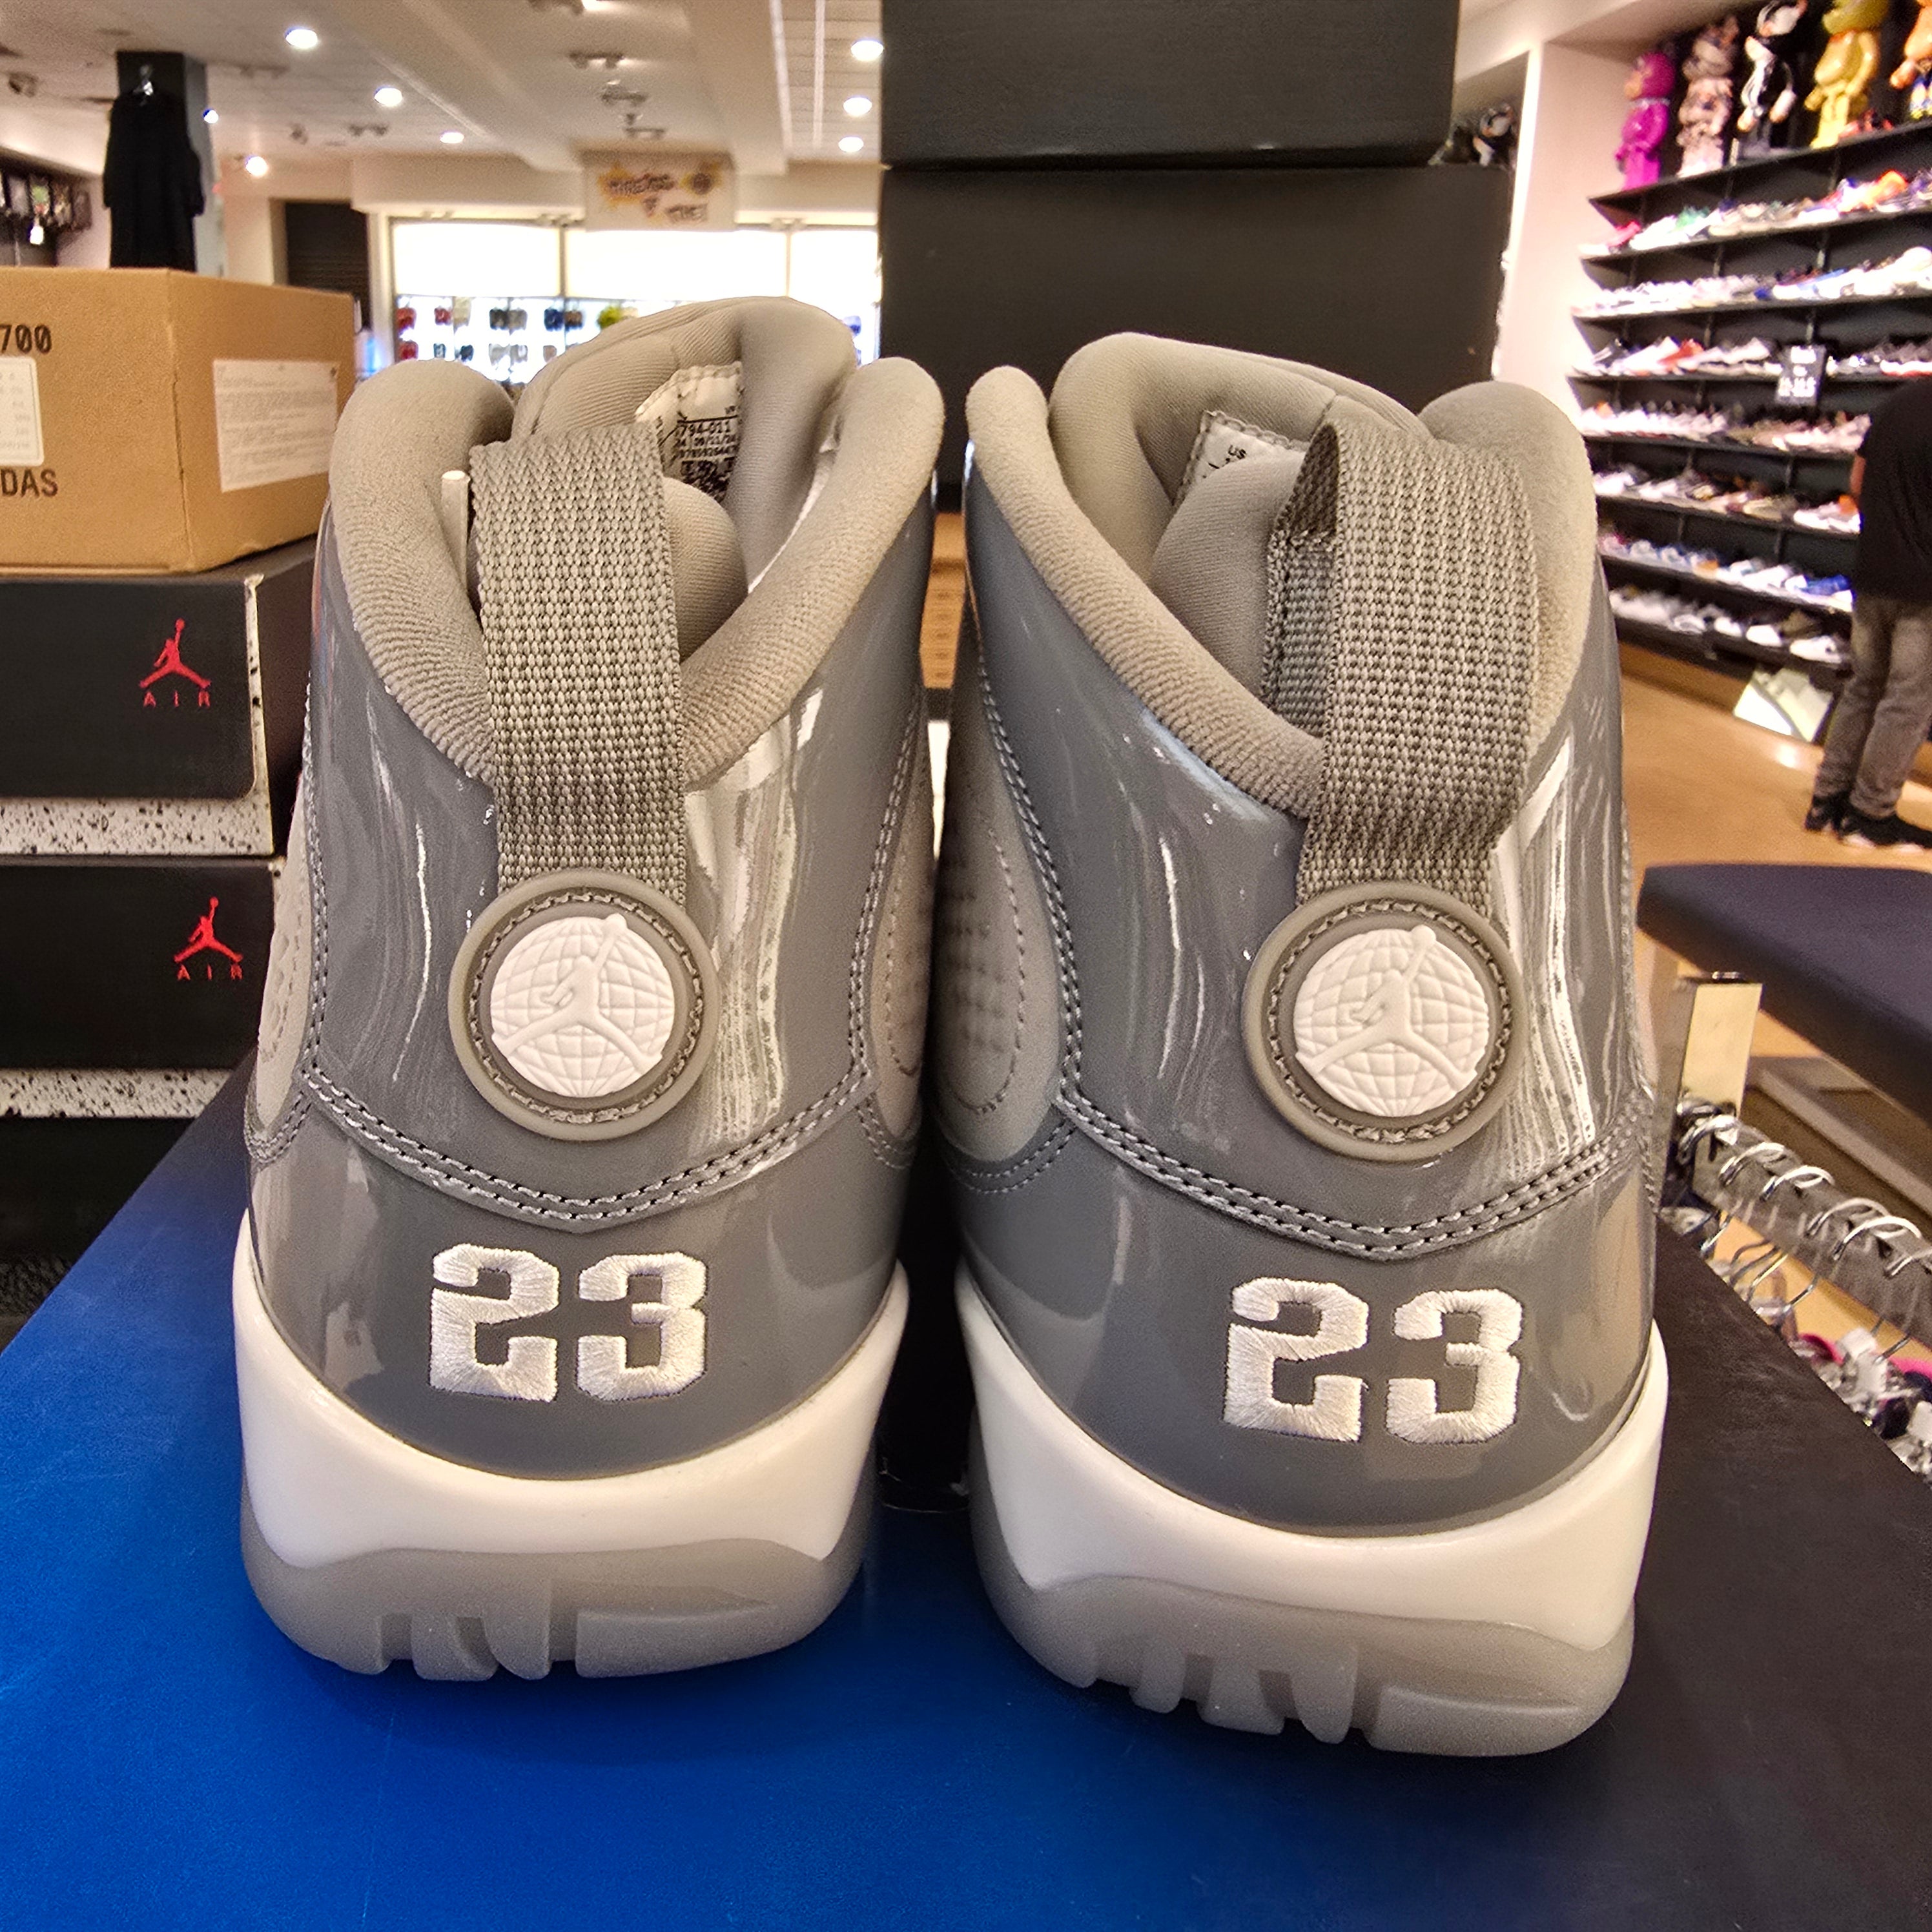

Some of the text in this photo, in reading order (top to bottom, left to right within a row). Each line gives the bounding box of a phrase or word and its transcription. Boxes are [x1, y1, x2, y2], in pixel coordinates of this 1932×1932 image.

[0, 324, 52, 353] 700
[0, 468, 58, 498] DAS
[143, 690, 211, 708] AIR
[177, 963, 243, 981] AIR
[429, 1243, 708, 1403] 23
[1224, 1277, 1523, 1444] 23
